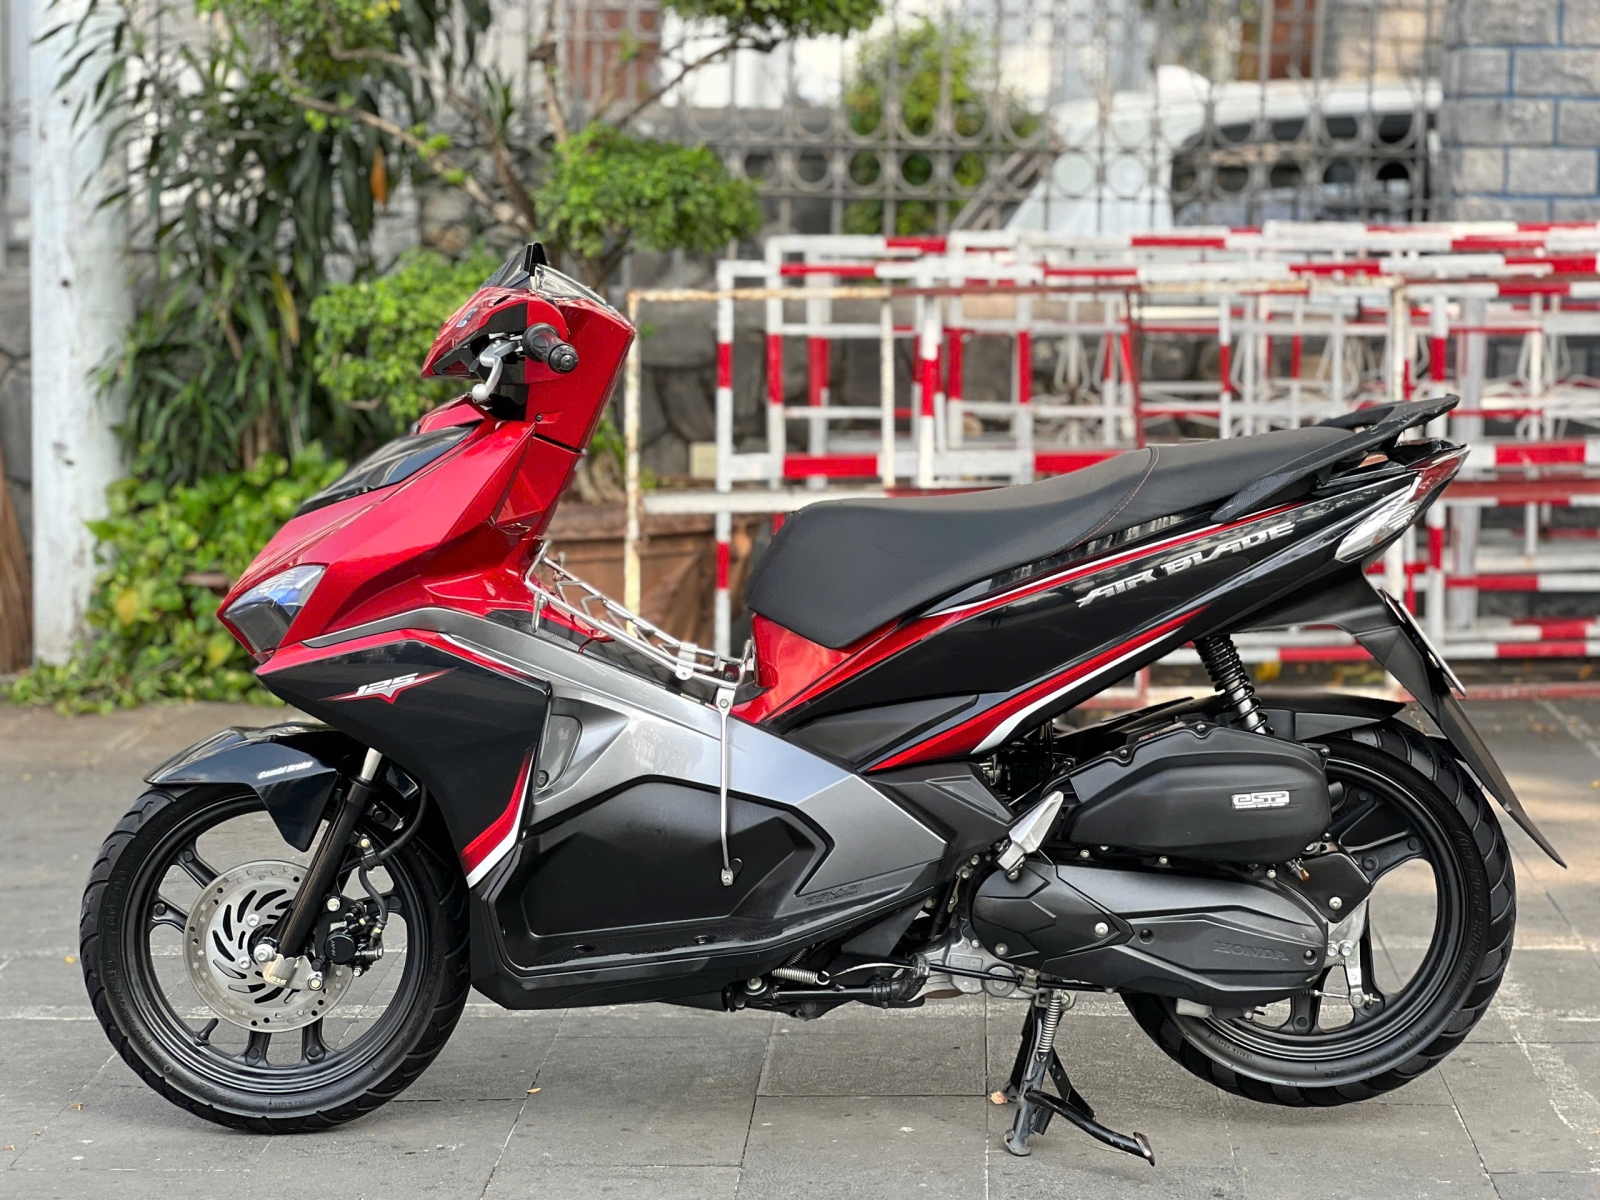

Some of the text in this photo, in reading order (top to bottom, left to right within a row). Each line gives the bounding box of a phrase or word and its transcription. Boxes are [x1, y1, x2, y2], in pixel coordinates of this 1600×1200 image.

[1075, 522, 1296, 608] AIR BLADE
[355, 672, 420, 697] 125
[1213, 940, 1291, 962] HONDA
